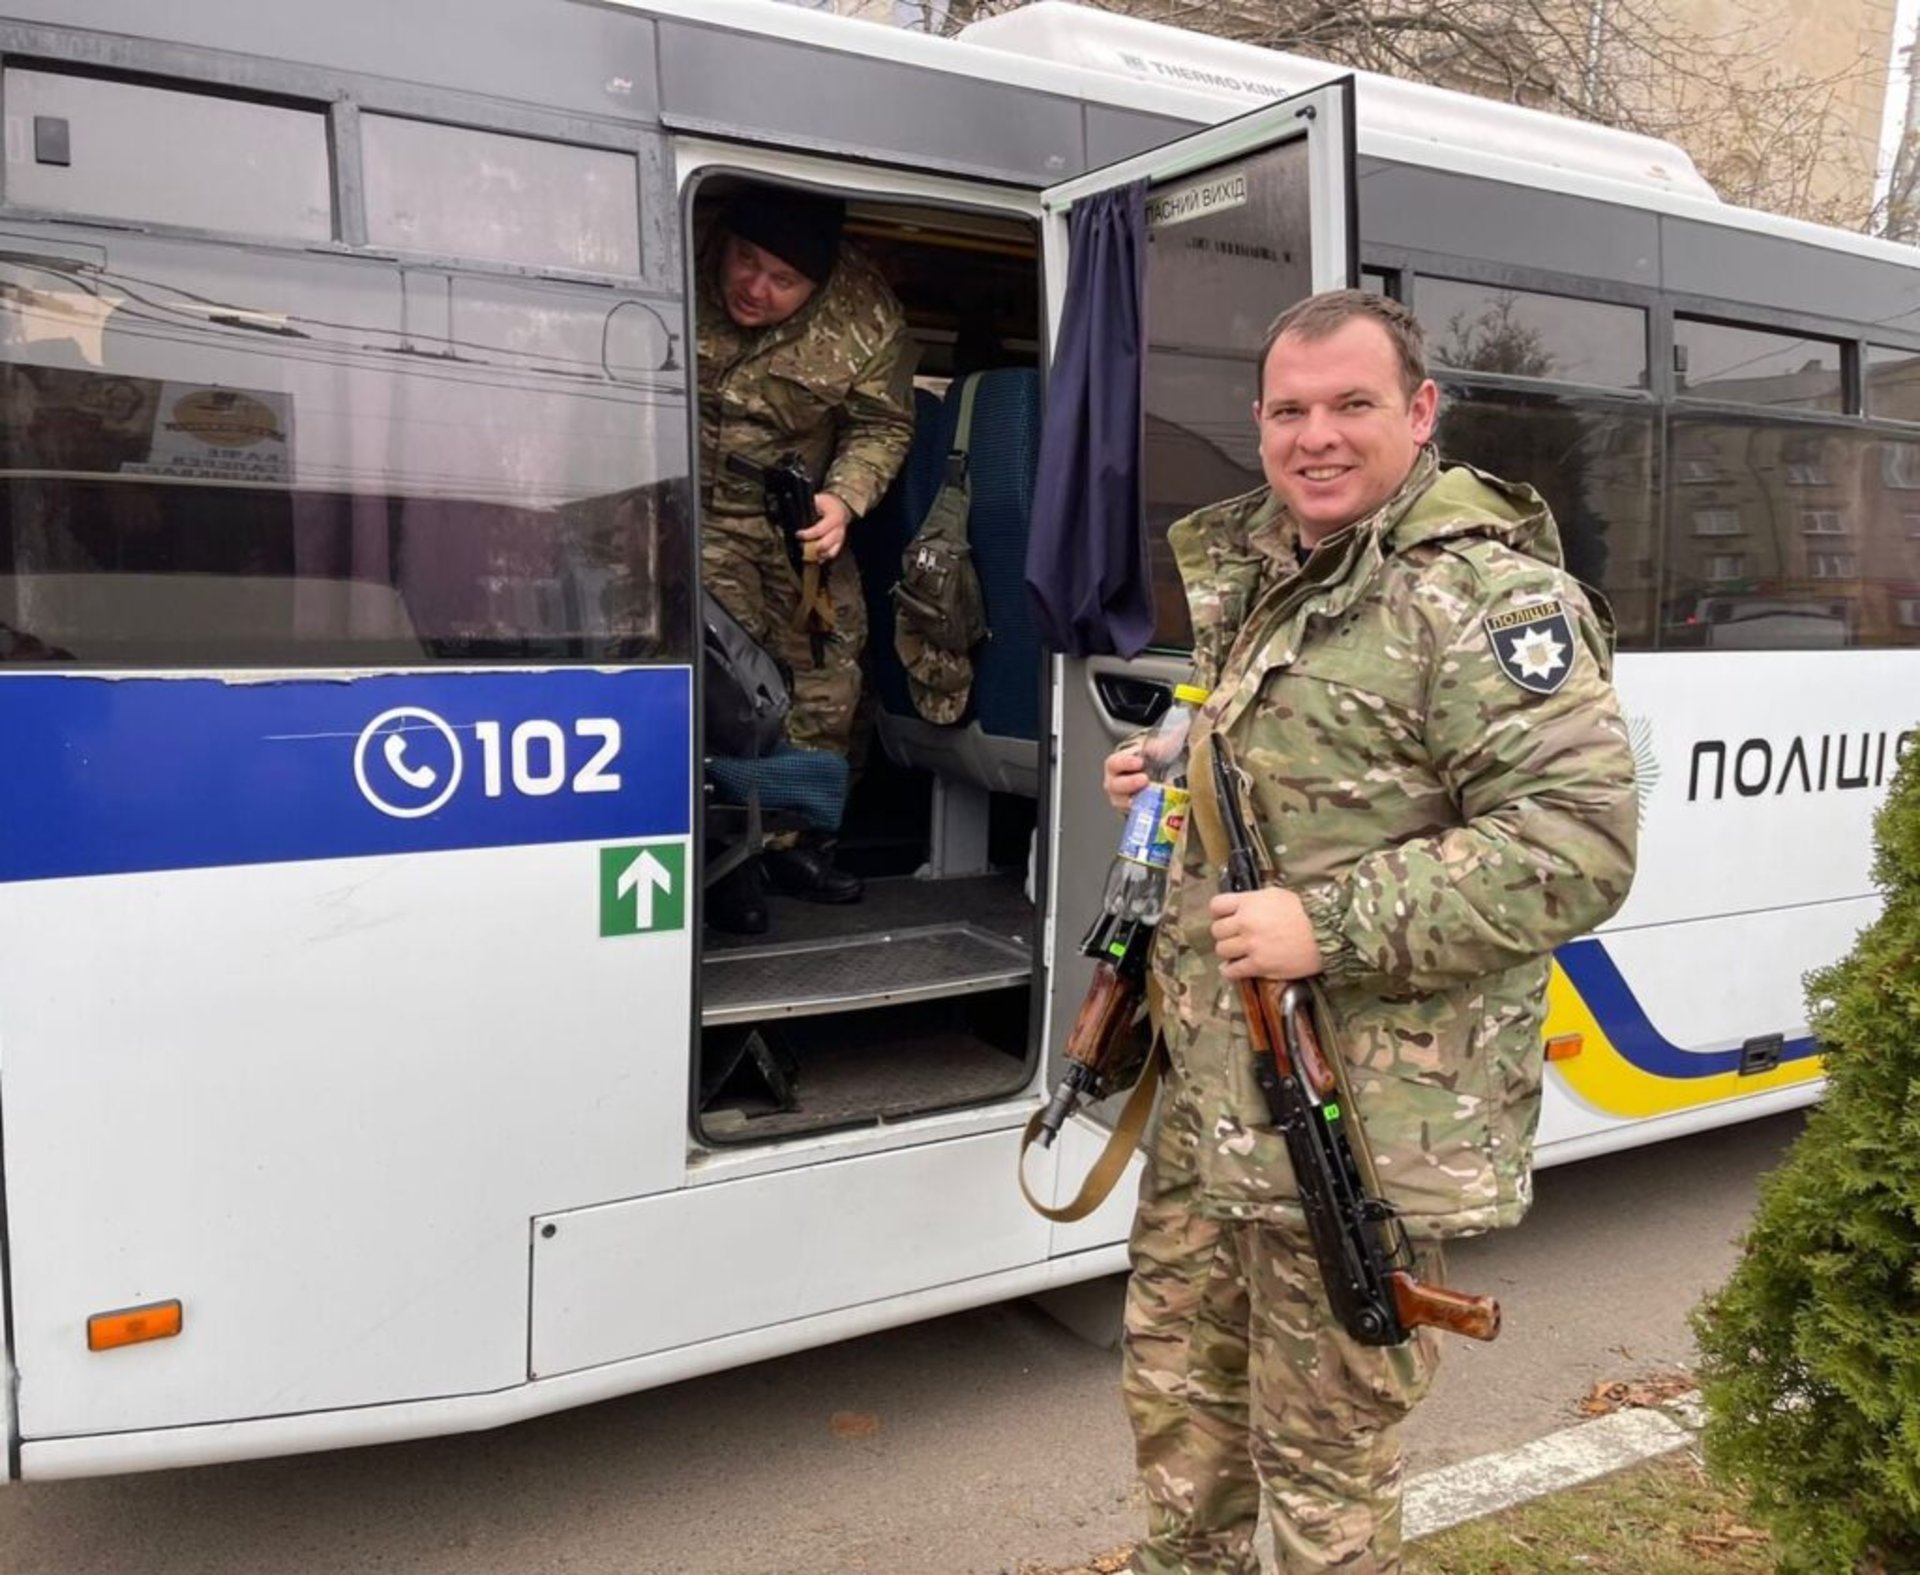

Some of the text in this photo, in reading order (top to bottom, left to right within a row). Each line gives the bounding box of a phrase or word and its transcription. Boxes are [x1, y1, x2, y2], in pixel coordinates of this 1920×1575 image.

[1149, 60, 1240, 91] THERMO
[1144, 177, 1246, 226] ПАСНИЙ ВИХІД
[1490, 601, 1556, 630] ПОЛІЦІЯ
[475, 717, 622, 797] 102
